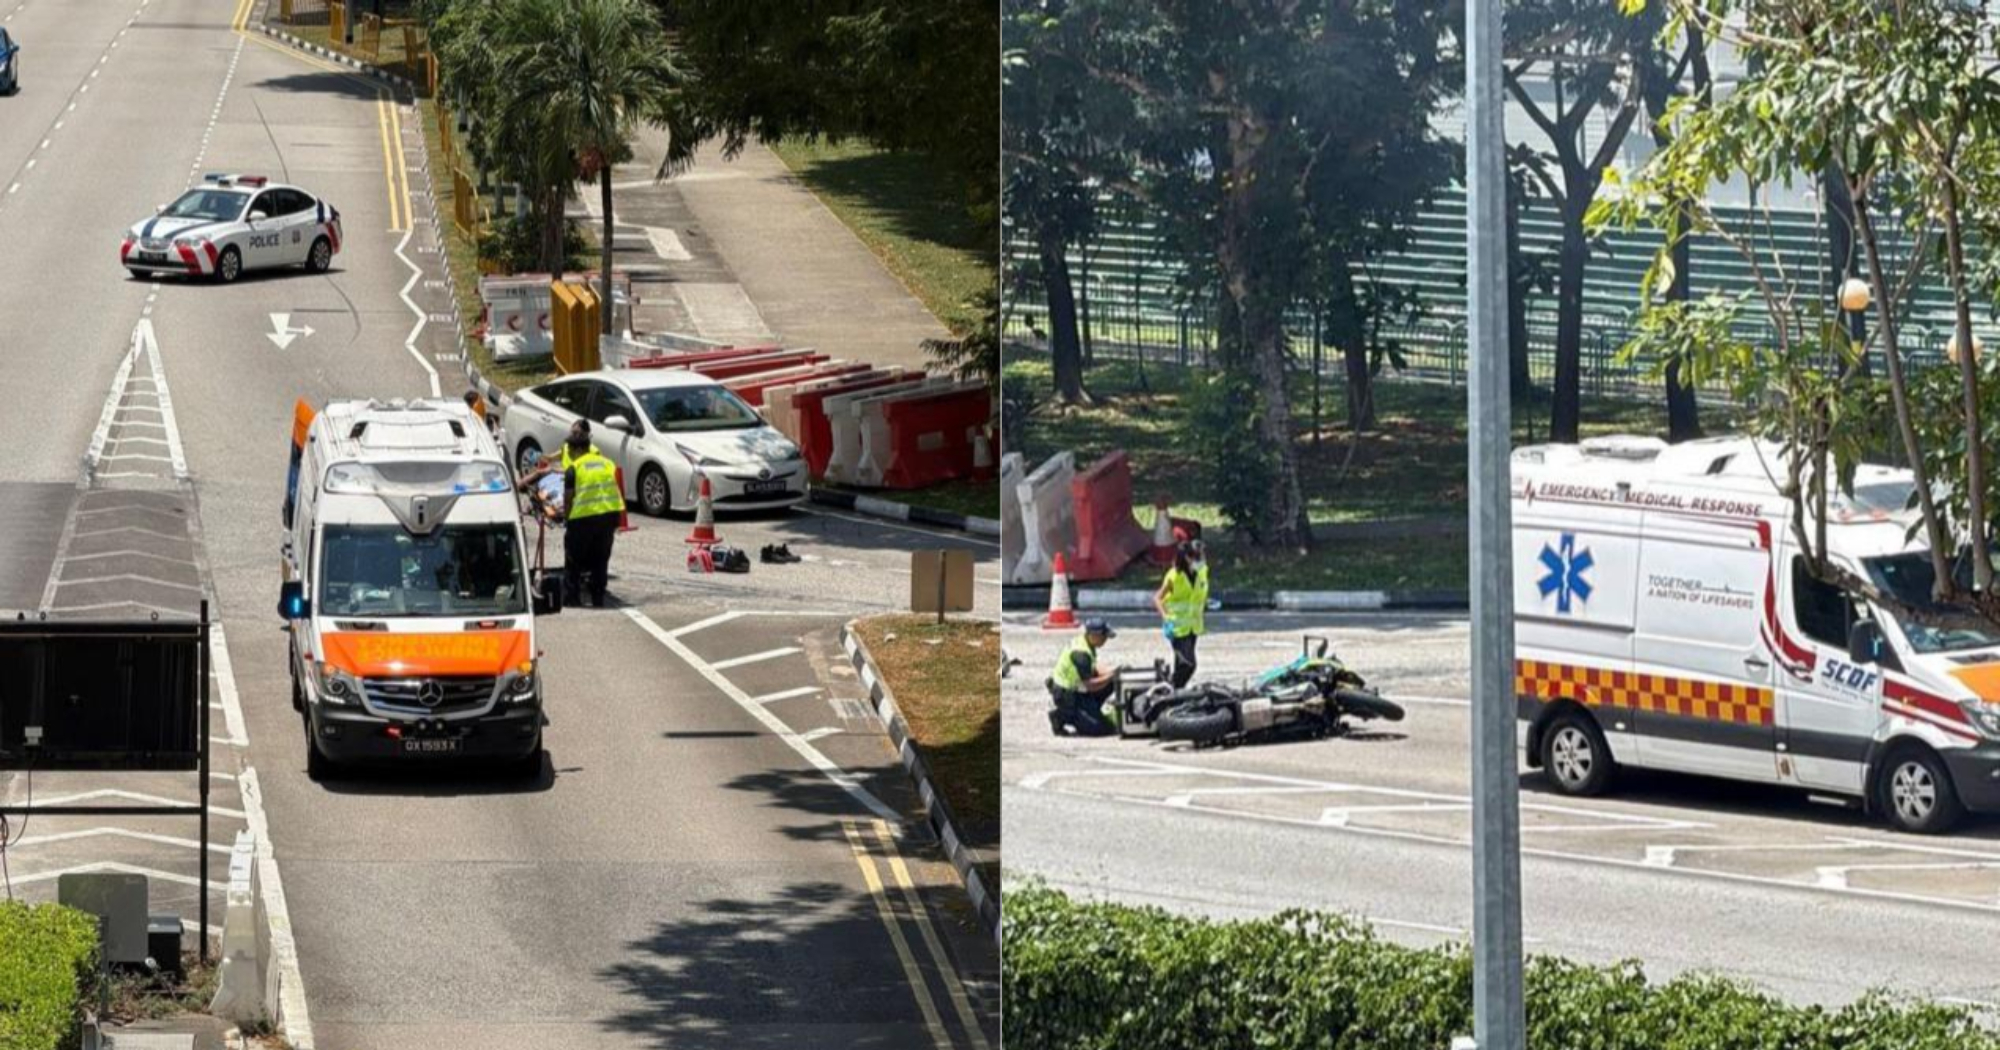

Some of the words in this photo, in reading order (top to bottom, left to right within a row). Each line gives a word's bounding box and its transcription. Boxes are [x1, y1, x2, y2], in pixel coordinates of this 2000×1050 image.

[249, 233, 280, 250] POLICE
[1540, 483, 1615, 502] EMERGENCY
[1624, 491, 1685, 509] MEDICAL
[1690, 495, 1763, 516] RESPONSE
[1649, 574, 1702, 590] TOGETHER
[1656, 589, 1687, 601] NATION
[1688, 592, 1701, 602] OF
[1701, 593, 1754, 610] LIFESAVERS
[1821, 658, 1878, 691] SCDF
